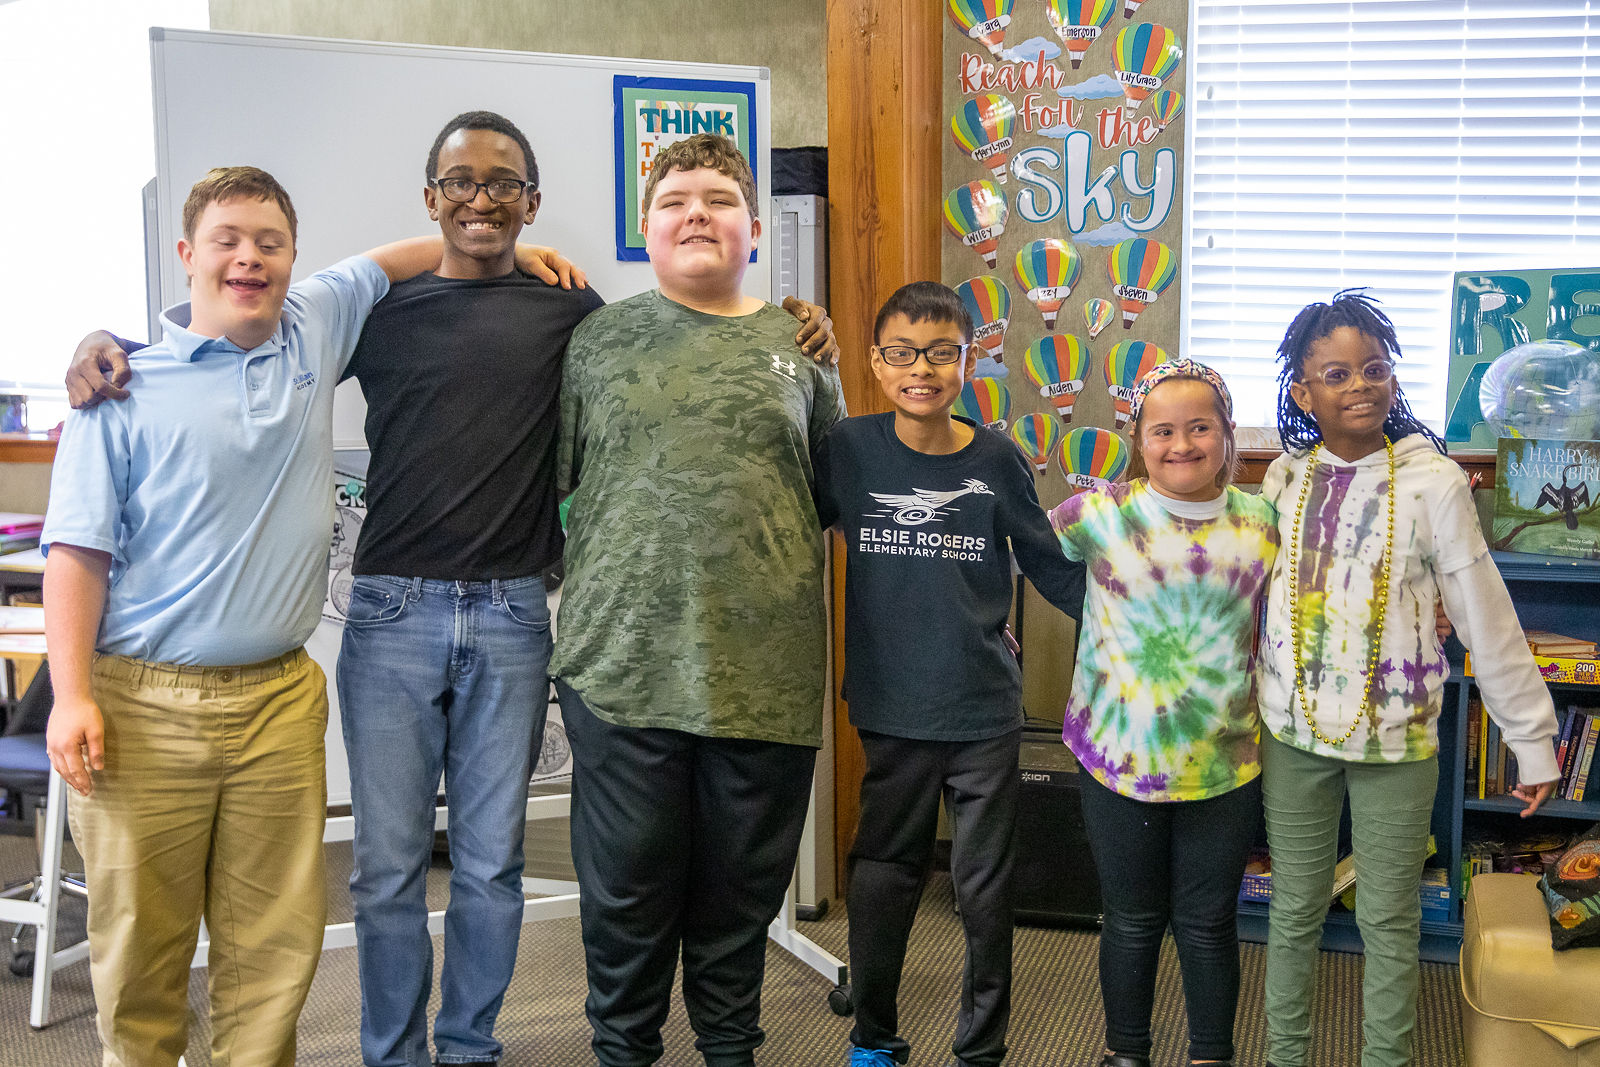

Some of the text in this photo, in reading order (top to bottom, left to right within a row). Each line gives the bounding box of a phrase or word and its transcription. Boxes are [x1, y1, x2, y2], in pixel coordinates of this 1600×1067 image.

[1062, 26, 1096, 38] Emerson
[961, 50, 1064, 93] Reach
[639, 108, 735, 135] THINK
[1097, 107, 1159, 149] the
[641, 142, 654, 157] T
[967, 228, 993, 244] Wiley
[1118, 285, 1148, 300] Steven
[1048, 382, 1073, 396] Aiden
[1529, 447, 1589, 464] HARRY
[1075, 475, 1096, 487] Pete
[860, 527, 986, 551] ELSIE ROGERS
[859, 543, 984, 562] ELEMENTARY SCHOOL
[1576, 663, 1595, 673] 200
